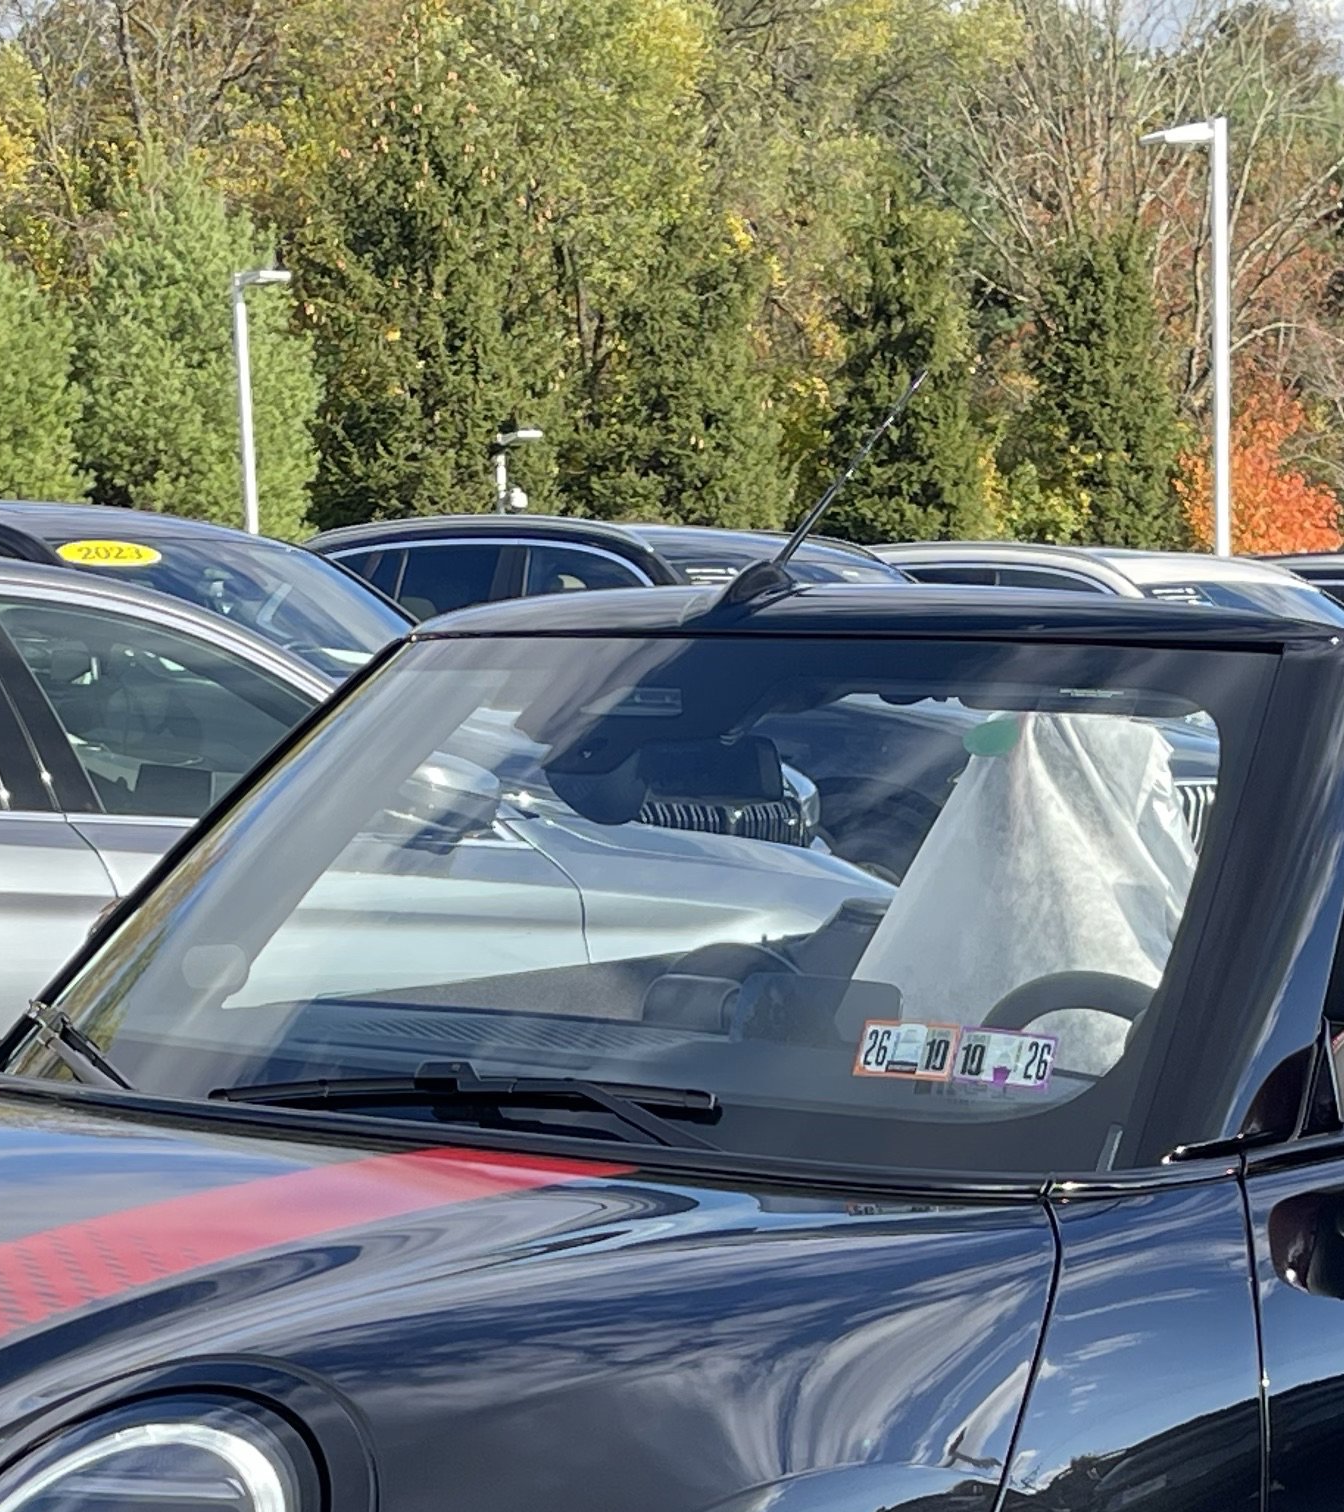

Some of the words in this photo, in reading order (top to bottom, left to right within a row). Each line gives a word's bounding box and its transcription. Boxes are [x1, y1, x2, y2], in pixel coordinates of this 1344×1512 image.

[77, 546, 143, 560] 2023
[863, 1029, 890, 1066] 26
[925, 1039, 950, 1071] 10
[960, 1043, 986, 1076] 10
[1023, 1041, 1052, 1080] 26
